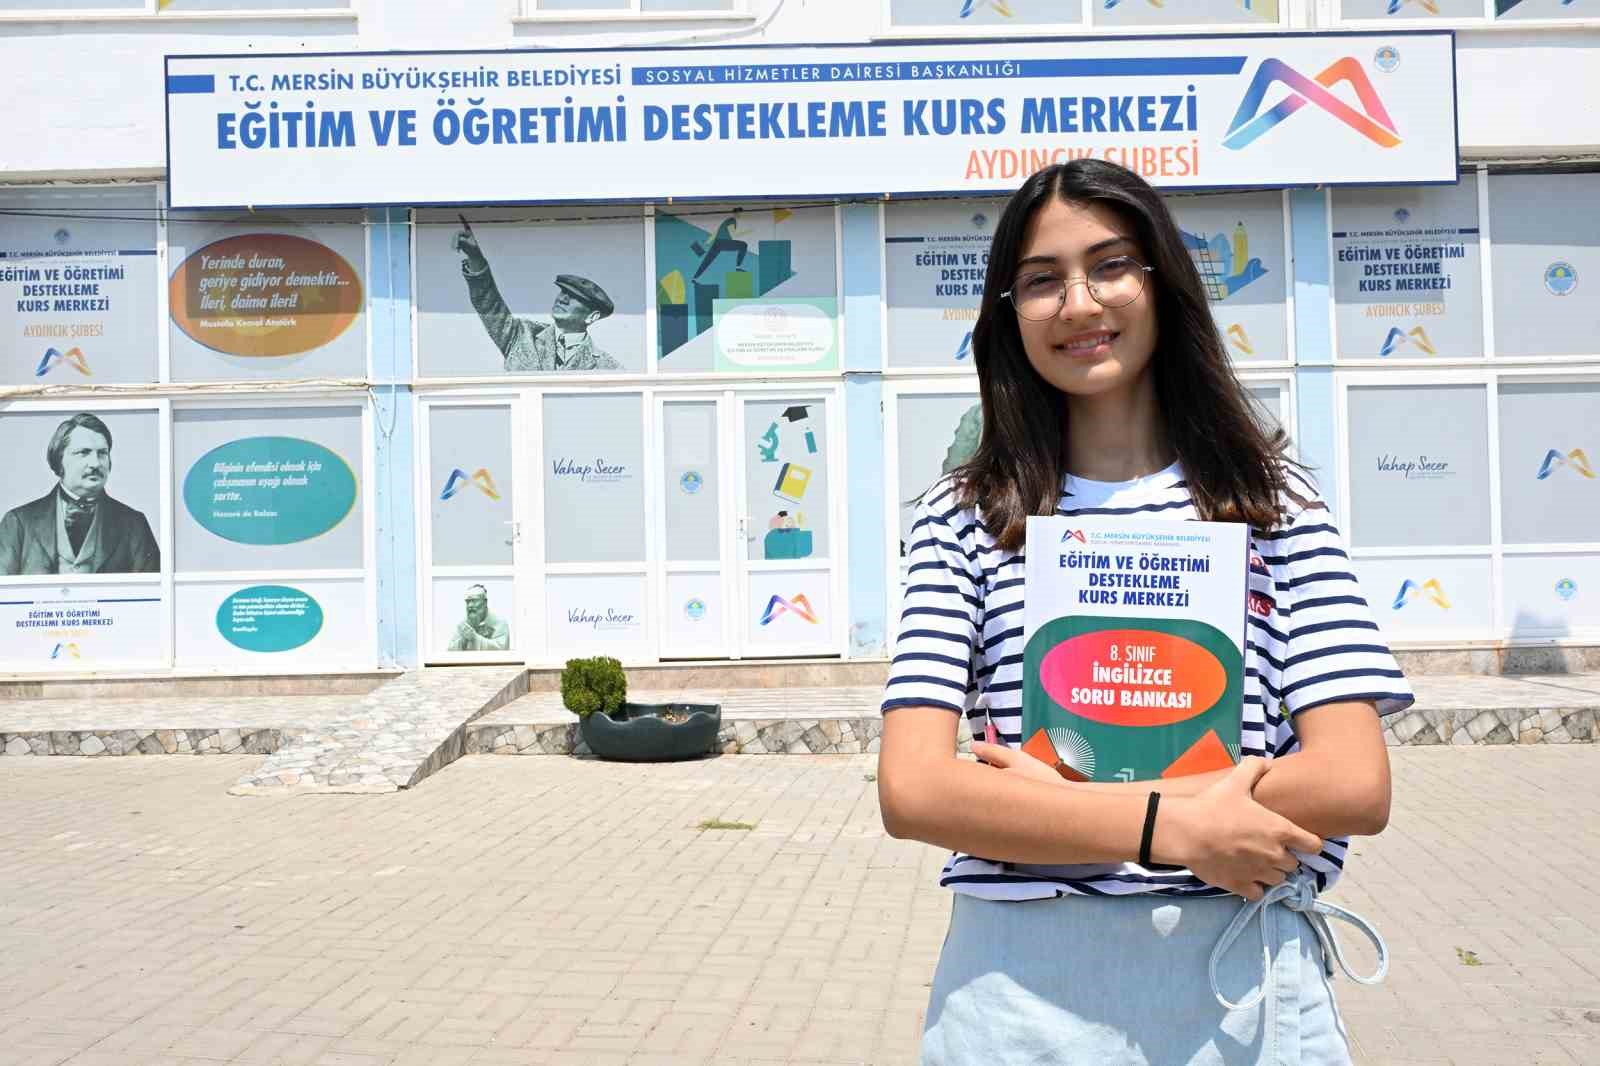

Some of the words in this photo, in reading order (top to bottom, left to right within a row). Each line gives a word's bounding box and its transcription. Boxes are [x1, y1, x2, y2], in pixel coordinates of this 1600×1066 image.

[229, 75, 265, 92] T.C.
[271, 69, 354, 91] MERSİN
[361, 66, 500, 93] BÜYÜKŞEHİR
[507, 63, 622, 87] BELEDİYESİ
[645, 69, 715, 83] SOSYAL
[724, 65, 821, 82] HİZMETLER
[831, 62, 901, 80] DAİRESİ
[911, 60, 1021, 80] BAŞKANLIĞI
[217, 101, 356, 150] EĞİTİM
[368, 109, 417, 147] VE
[432, 94, 628, 146] ÖĞRETİMİ
[643, 99, 887, 142] DESTEKLEME
[903, 97, 1005, 137] KURS
[1021, 84, 1198, 135] MERKEZİ
[200, 254, 246, 270] Yerinde
[248, 253, 286, 270] duran,
[915, 250, 959, 267] EĞİTİM
[962, 253, 977, 265] VE
[1338, 245, 1381, 262] EĞİTİM
[1384, 248, 1401, 260] VE
[1404, 242, 1465, 259] ÖĞRETİMİ
[0, 265, 40, 282] EĞİTİM
[44, 269, 60, 281] VE
[63, 264, 125, 281] ÖĞRETİMİ
[941, 268, 985, 281] DESTEK
[1364, 262, 1441, 277] DESTEKLEME
[23, 283, 100, 297] DESTEKLEME
[199, 274, 238, 292] geriye
[240, 272, 283, 292] gidiyor
[935, 284, 968, 297] KURS
[1359, 279, 1392, 292] KURS
[1395, 274, 1452, 291] MERKEZİ
[17, 299, 50, 312] KURS
[54, 295, 110, 312] MERKEZİ
[231, 294, 268, 309] daima
[552, 457, 592, 482] Vahap
[1377, 454, 1416, 481] Vahap
[1059, 550, 1111, 569] EĞİTİM
[1116, 555, 1134, 570] VE
[1139, 552, 1211, 573] ÖĞRETİMİ
[1088, 573, 1181, 590] DESTEKLEME
[1078, 589, 1118, 605] KURS
[1122, 588, 1190, 607] MERKEZİ
[55, 611, 65, 619] VE
[568, 607, 603, 630] Vahap
[1109, 644, 1122, 662] 8.
[1125, 645, 1156, 663] SINIF
[1092, 661, 1173, 686] İNGİLİZCE
[1071, 688, 1115, 706] SORU
[1119, 690, 1193, 709] BANKASI
